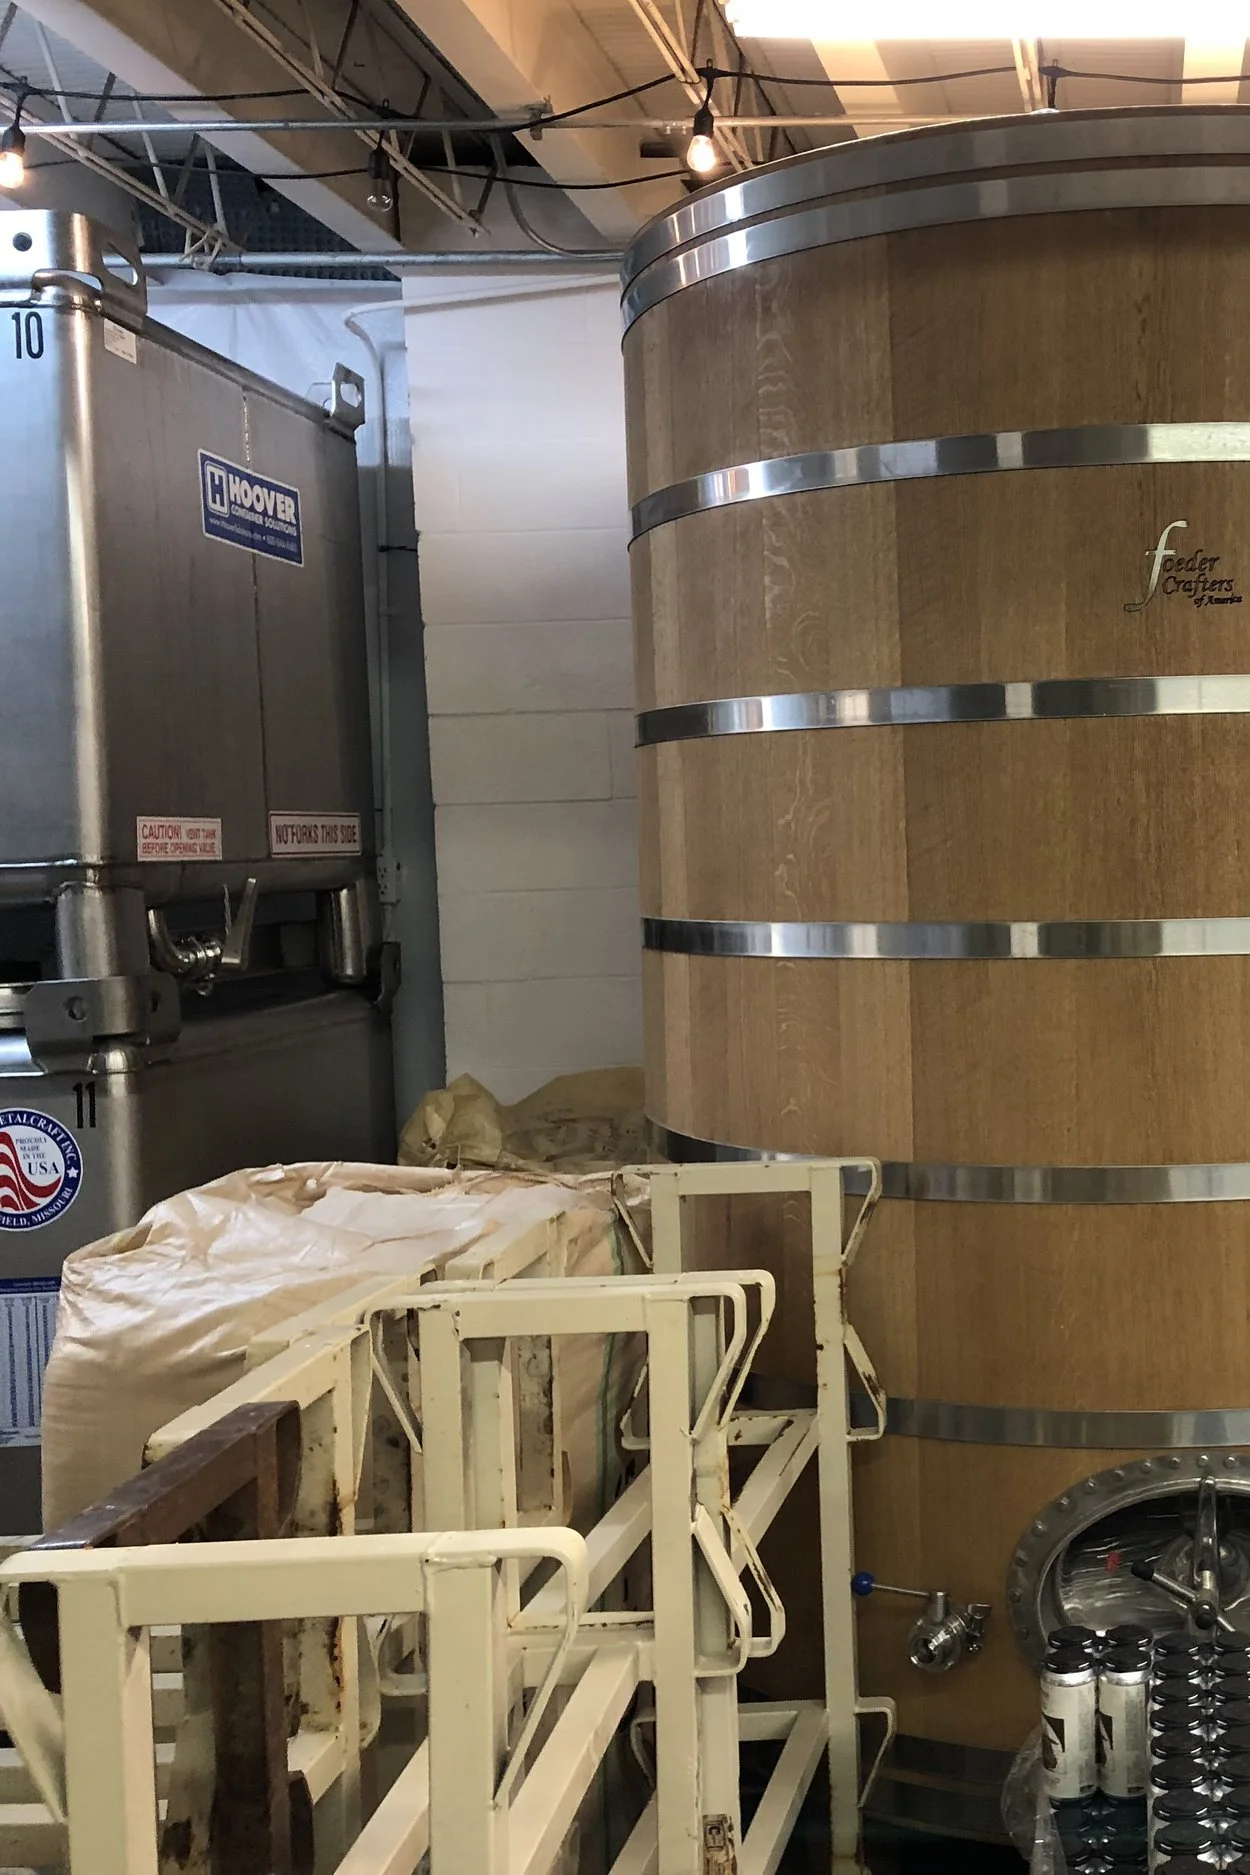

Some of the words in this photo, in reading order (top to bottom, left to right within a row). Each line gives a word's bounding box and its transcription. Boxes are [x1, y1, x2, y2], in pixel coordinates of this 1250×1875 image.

[11, 311, 44, 359] 10
[228, 473, 296, 525] HOOVER
[1162, 573, 1234, 598] Crafters
[1194, 595, 1205, 607] of
[1205, 593, 1243, 605] America
[142, 823, 182, 840] CAUTION!
[275, 824, 288, 845] NO
[289, 824, 319, 845] FORKS
[320, 824, 338, 844] THIS
[340, 824, 357, 844] SIDE
[142, 842, 169, 854] BEFORE
[72, 1082, 96, 1129] 11
[28, 1161, 60, 1176] USA
[31, 1187, 73, 1223] MISSOURI
